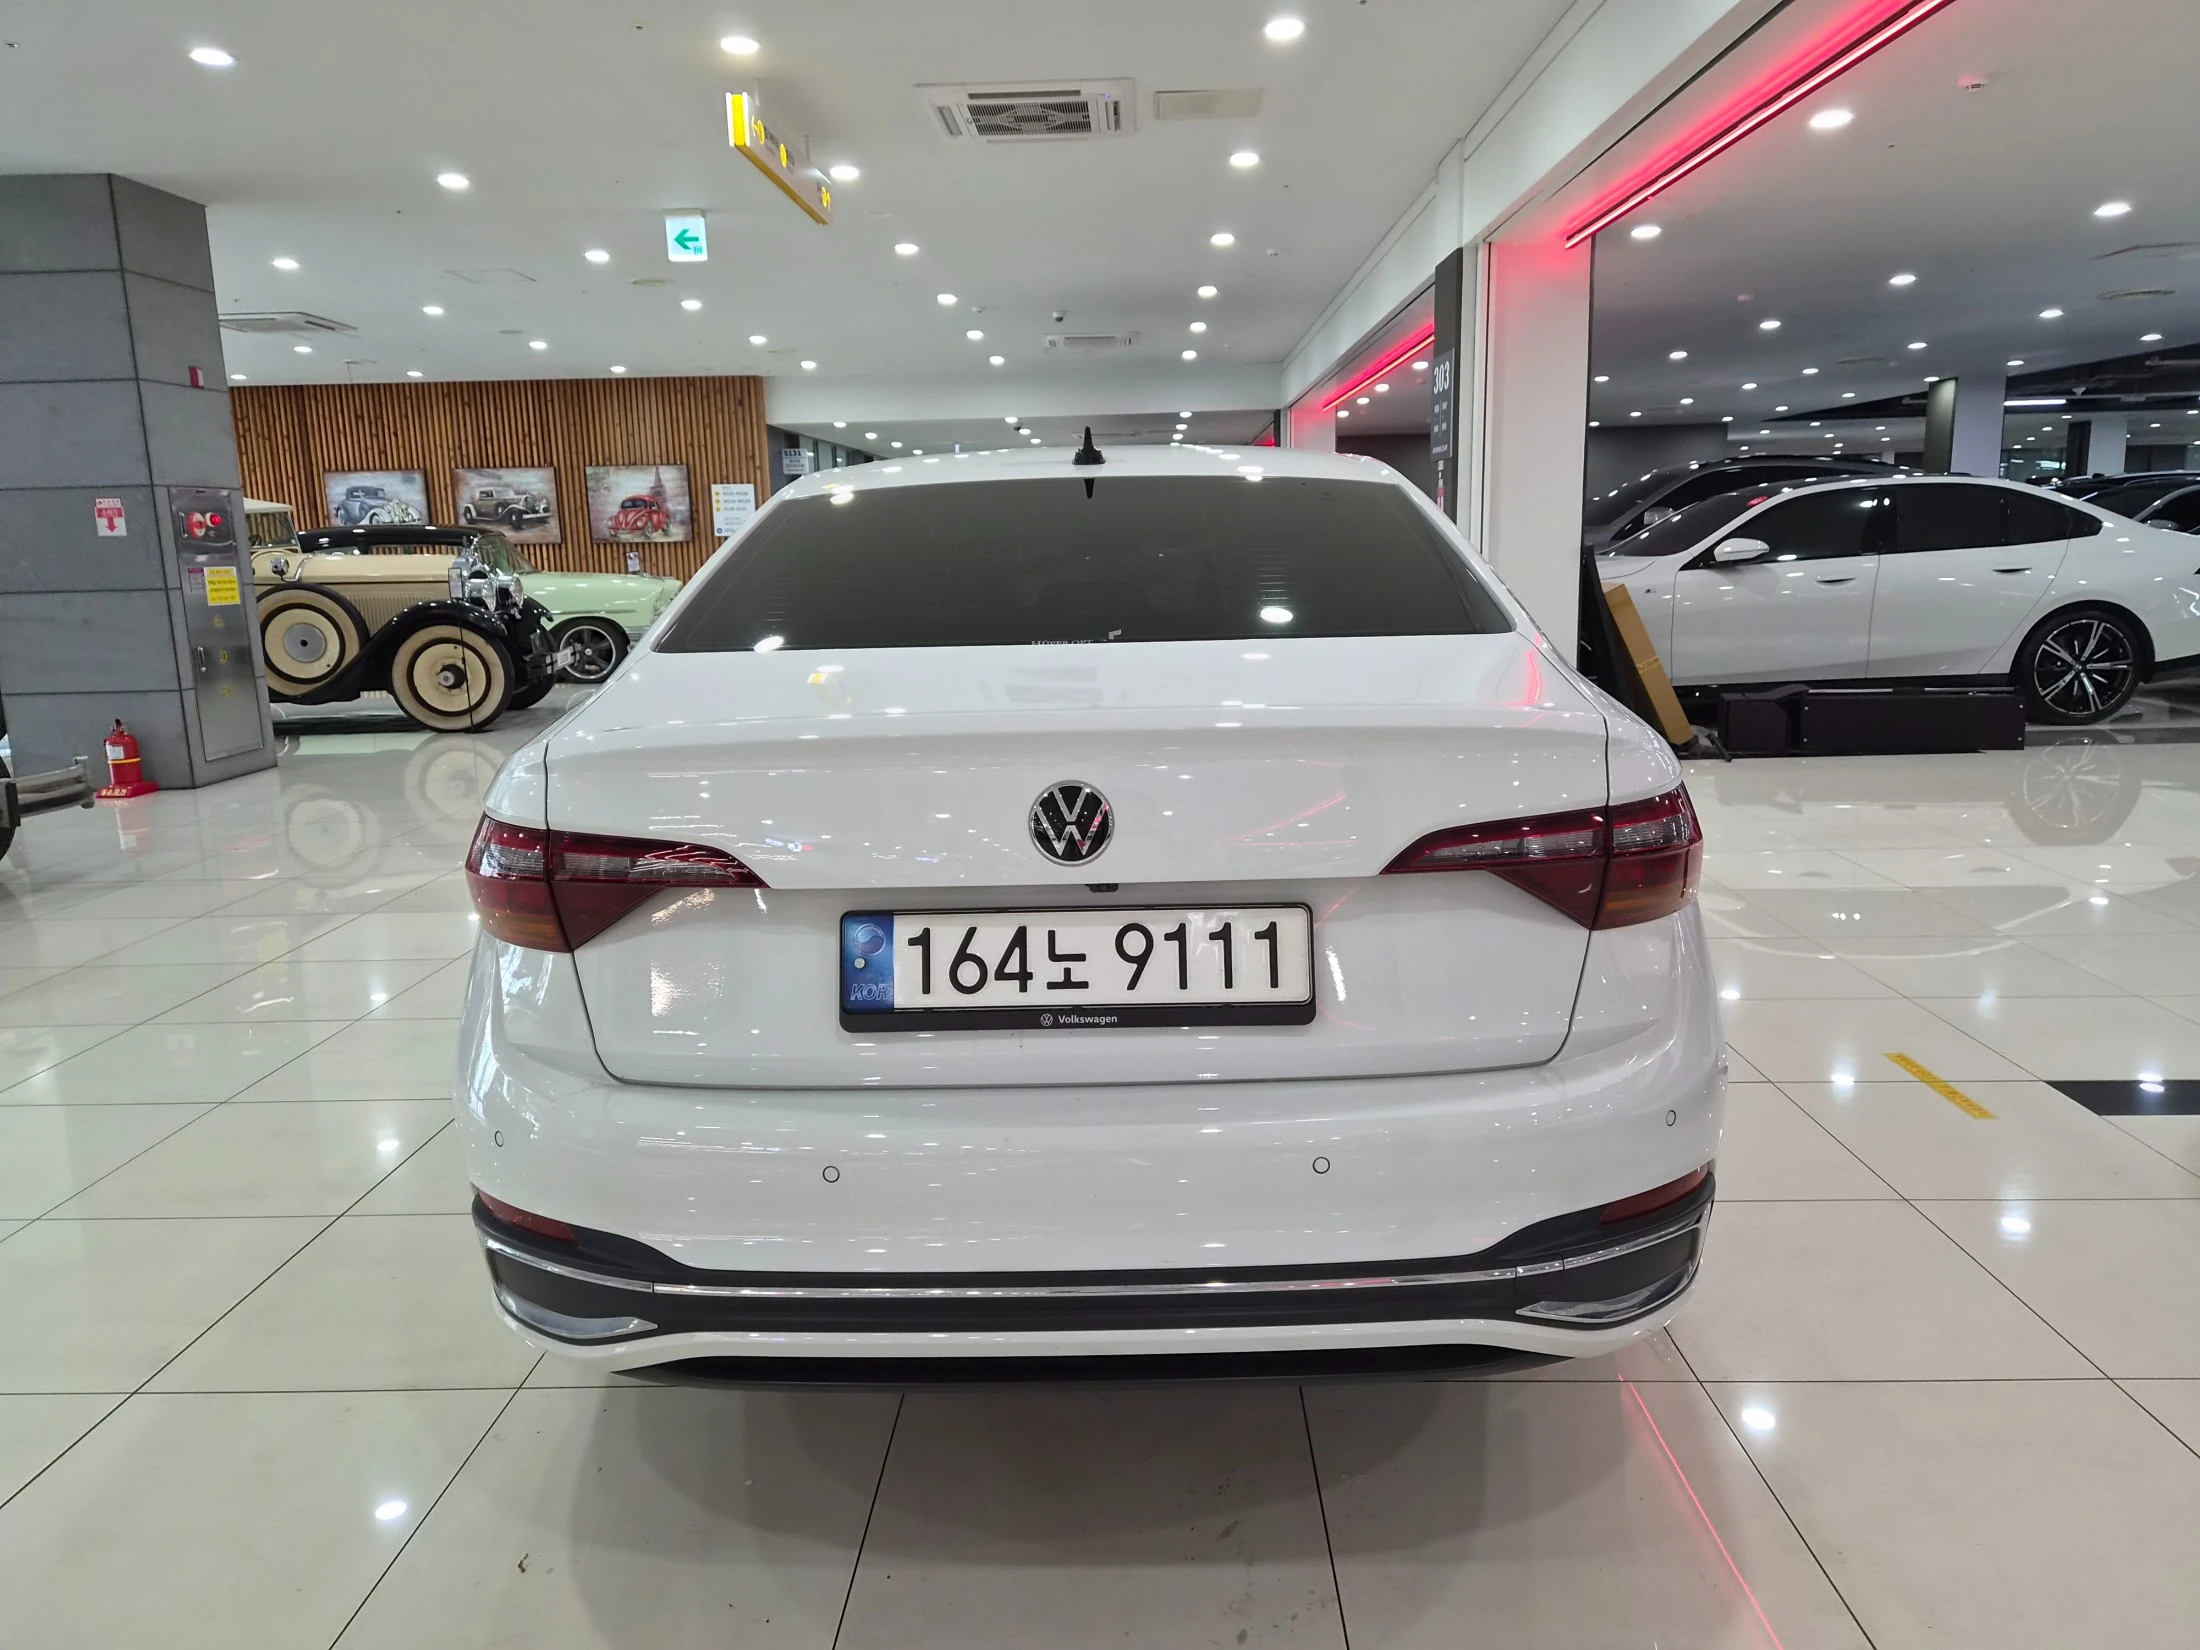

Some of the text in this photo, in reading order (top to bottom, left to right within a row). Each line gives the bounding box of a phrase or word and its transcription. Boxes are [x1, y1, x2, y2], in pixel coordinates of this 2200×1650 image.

[1433, 361, 1450, 395] 303
[907, 921, 1278, 995] 164노 9111
[850, 983, 890, 1001] KOR
[1058, 1014, 1118, 1025] Volkswagen
